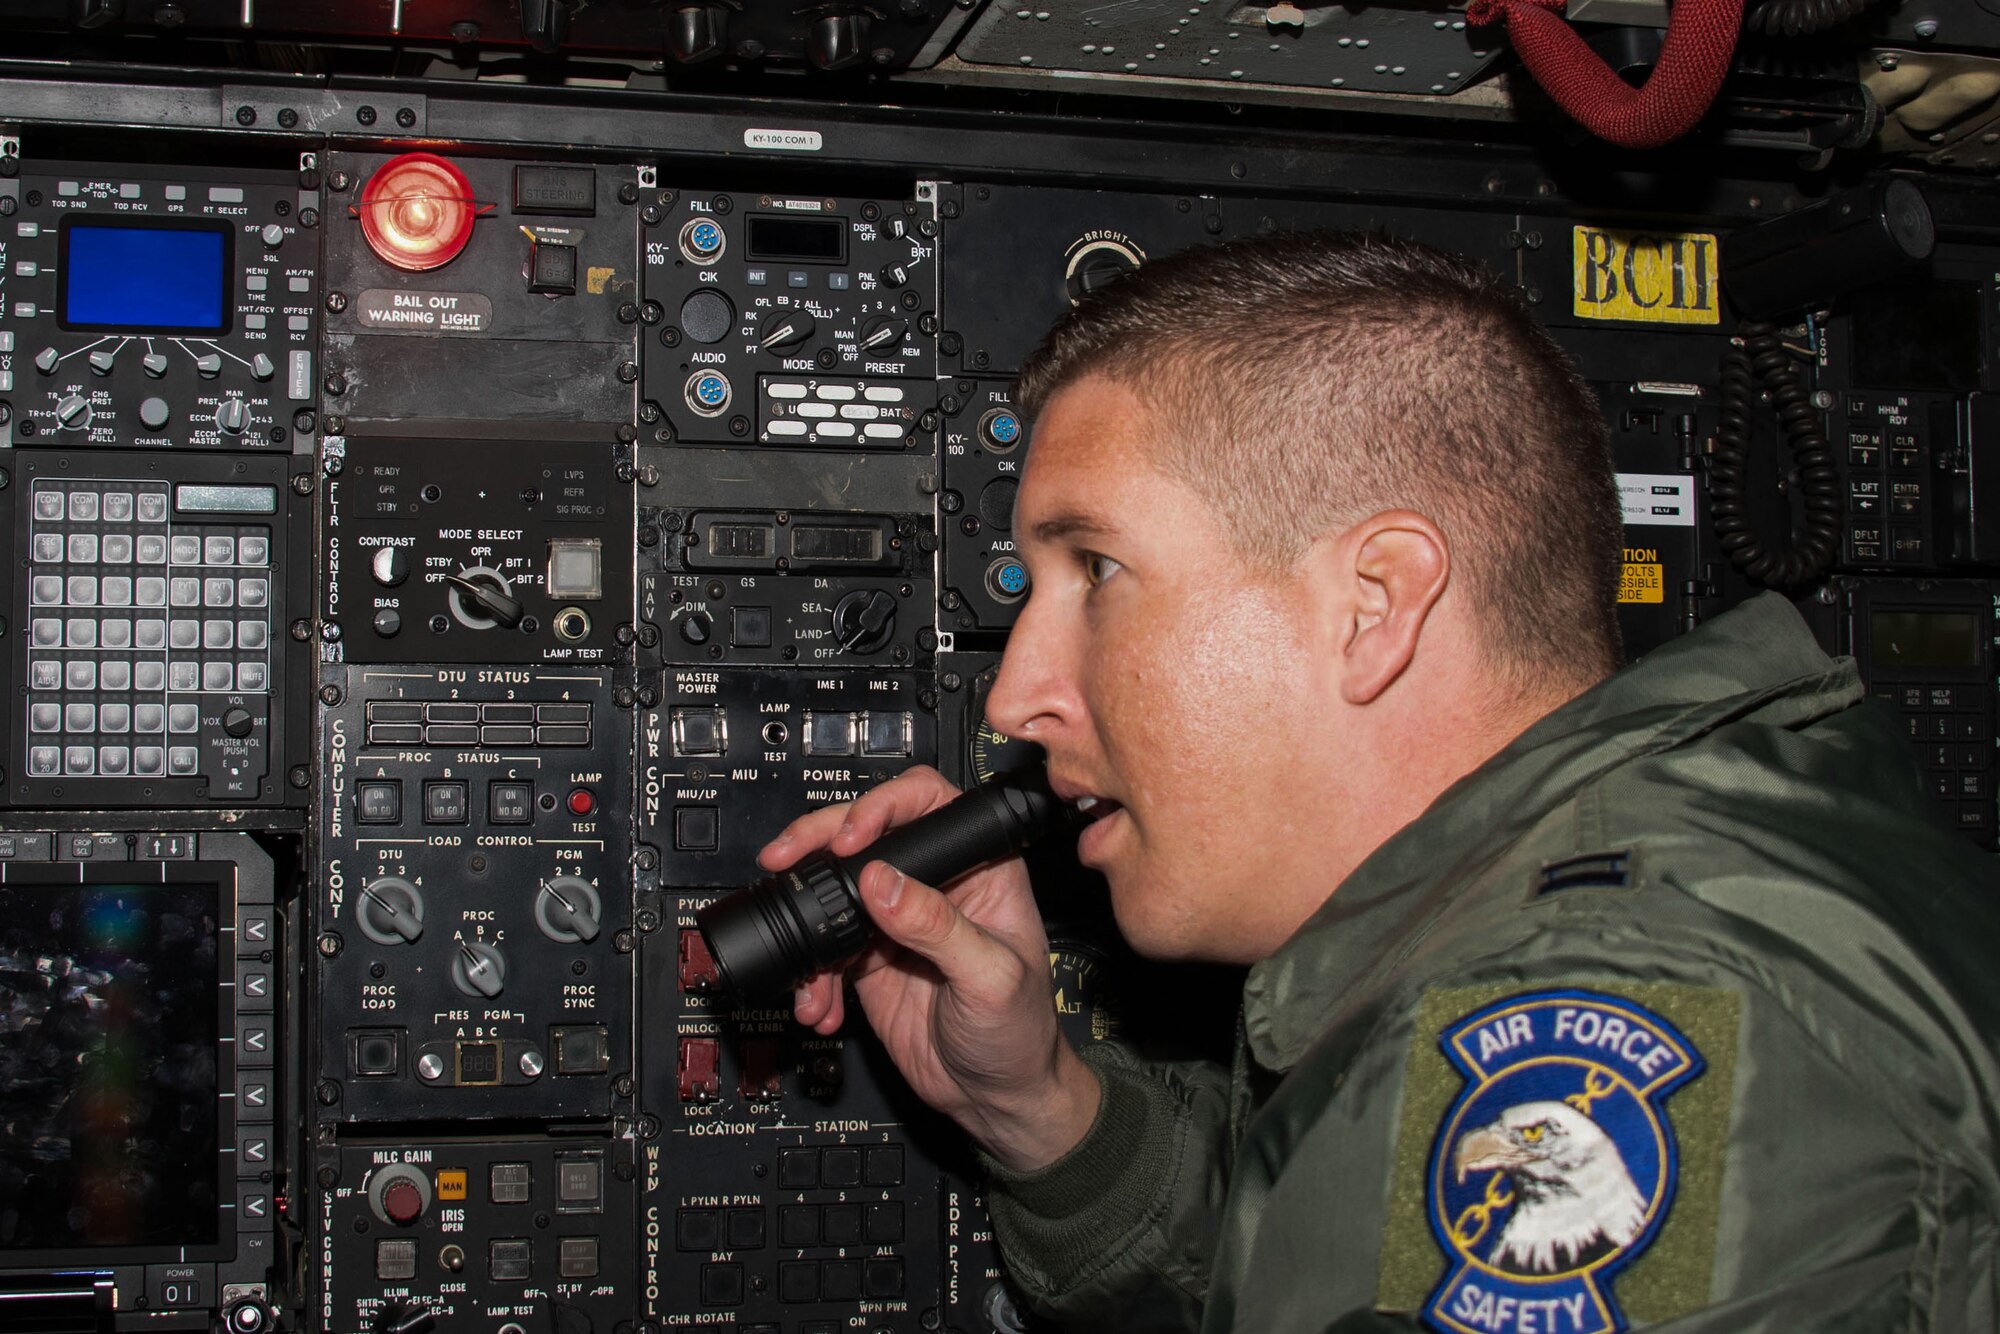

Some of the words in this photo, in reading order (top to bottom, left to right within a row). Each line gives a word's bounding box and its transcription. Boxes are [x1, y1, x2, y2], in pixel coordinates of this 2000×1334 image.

[753, 135, 783, 143] KY-100
[785, 136, 806, 144] COM
[690, 201, 712, 212] FILL
[853, 223, 875, 233] DSPL
[861, 232, 877, 241] OFF
[1084, 229, 1128, 244] BRIGHT
[647, 243, 669, 254] KY-
[911, 247, 932, 258] BRT
[647, 254, 664, 265] 100
[246, 267, 269, 275] MENU
[1580, 230, 1712, 309] BCH
[699, 272, 718, 282] CIK
[749, 272, 765, 281] INIT
[858, 273, 875, 281] PNL
[861, 281, 877, 290] OFF
[247, 293, 266, 301] TIME
[394, 294, 423, 307] BAIL
[428, 297, 458, 309] OUT
[755, 298, 772, 307] OFL
[804, 300, 822, 309] ALL
[237, 305, 275, 314] XMT/RCV
[368, 309, 435, 324] WARNING
[441, 313, 481, 326] LIGHT
[834, 331, 854, 339] MAN
[838, 344, 857, 352] PWR
[1819, 327, 1827, 366] TCOM
[843, 352, 859, 361] OFF
[902, 348, 920, 357] REM
[691, 353, 726, 364] AUDIO
[783, 359, 814, 370] MODE
[865, 363, 905, 373] PRESET
[1852, 402, 1864, 412] LT
[880, 408, 901, 418] BAT
[1889, 415, 1908, 425] RDY
[134, 438, 173, 446] CHANNEL
[189, 437, 221, 445] MASTER
[947, 434, 968, 444] KY-
[1896, 436, 1914, 446] CLR
[948, 445, 964, 455] 100
[998, 462, 1015, 471] CIK
[1893, 484, 1920, 494] ENTR
[330, 482, 339, 526] FLIR
[439, 530, 472, 540] MODE
[477, 530, 523, 540] SELECT
[358, 536, 416, 547] CONTRAST
[471, 547, 491, 556] OPR
[1623, 548, 1657, 562] TION
[1857, 547, 1877, 557] SEL
[425, 558, 452, 567] STBY
[506, 558, 524, 568] BIT
[527, 559, 531, 567] 1
[330, 537, 339, 615] CONTROL
[425, 574, 446, 583] OFF
[517, 575, 535, 584] BIT
[537, 575, 544, 584] 2
[672, 576, 700, 586] TEST
[740, 577, 756, 587] GS
[814, 578, 828, 589] DA
[1620, 578, 1659, 588] SSIBLE
[374, 598, 399, 608] BIAS
[645, 577, 655, 619] NAV
[685, 602, 706, 612] DIM
[802, 603, 822, 613] SEA
[795, 630, 823, 639] LAND
[543, 649, 573, 658] LAMP
[577, 649, 603, 658] TEST
[814, 649, 835, 658] OFF
[243, 672, 263, 681] MUTE
[438, 671, 466, 682] DTU
[478, 671, 530, 683] STATUS
[676, 673, 719, 683] MASTER
[678, 683, 717, 694] POWER
[817, 680, 836, 689] IME
[839, 680, 843, 689] 1
[869, 681, 888, 690] IME
[891, 681, 899, 690] 2
[1932, 690, 1950, 698] HELP
[228, 696, 244, 705] VOL
[760, 703, 790, 713] LAMP
[203, 718, 220, 726] VOX
[646, 713, 660, 757] PWR
[211, 738, 240, 747] MASTER
[243, 738, 260, 747] VOL
[223, 746, 249, 756] (PUSH)
[174, 757, 192, 765] CALL
[399, 752, 432, 763] PROC
[457, 753, 500, 763] STATUS
[764, 752, 787, 762] TEST
[332, 719, 346, 838] COMPUTER
[571, 773, 602, 782] LAMP
[732, 770, 758, 780] MIU
[803, 770, 851, 781] POWER
[645, 766, 659, 826] CONT
[676, 789, 718, 800] MIU/LP
[806, 790, 858, 801] MIU/BAY
[572, 823, 596, 832] TEST
[428, 836, 462, 846] LOAD
[476, 836, 533, 846] CONTROL
[379, 850, 403, 860] DTU
[556, 850, 583, 860] PGM
[329, 860, 343, 918] CONT
[463, 911, 495, 920] PROC
[362, 985, 396, 995] PROC
[563, 985, 595, 995] PROC
[362, 999, 396, 1009] LOAD
[564, 998, 595, 1008] SYNC
[449, 1010, 470, 1020] RES
[484, 1010, 511, 1020] PGM
[731, 1010, 790, 1021] NUCLEAR
[677, 1024, 722, 1034] UNLOCK
[1477, 1014, 1535, 1062] AIR
[1554, 1009, 1674, 1078] FORCE
[684, 1106, 712, 1116] LOCK
[750, 1105, 770, 1115] OFF
[689, 1123, 756, 1136] LOCATION
[815, 1120, 869, 1132] STATION
[373, 1152, 398, 1164] MLC
[404, 1150, 432, 1163] GAIN
[647, 1146, 659, 1191] WPN
[443, 1182, 462, 1192] MAN
[337, 1188, 352, 1197] OFF
[324, 1192, 332, 1231] STV
[441, 1210, 465, 1222] IRIS
[442, 1222, 463, 1232] OPEN
[876, 1246, 894, 1256] ALL
[647, 1207, 659, 1315] CONTROL
[711, 1252, 733, 1262] BAY
[166, 1268, 194, 1277] POWER
[324, 1237, 332, 1331] CONTROL
[440, 1283, 466, 1293] CLOSE
[384, 1288, 408, 1297] ILLUM
[524, 1289, 539, 1298] OFF
[598, 1286, 614, 1295] OPR
[356, 1298, 378, 1308] SHTR
[859, 1303, 882, 1313] WPN
[887, 1302, 907, 1312] PWR
[487, 1307, 511, 1316] LAMP
[514, 1306, 533, 1315] TEST
[1452, 1284, 1586, 1334] SAFETY
[662, 1314, 690, 1324] LCHR
[695, 1312, 736, 1323] ROTATE
[849, 1317, 866, 1327] ON
